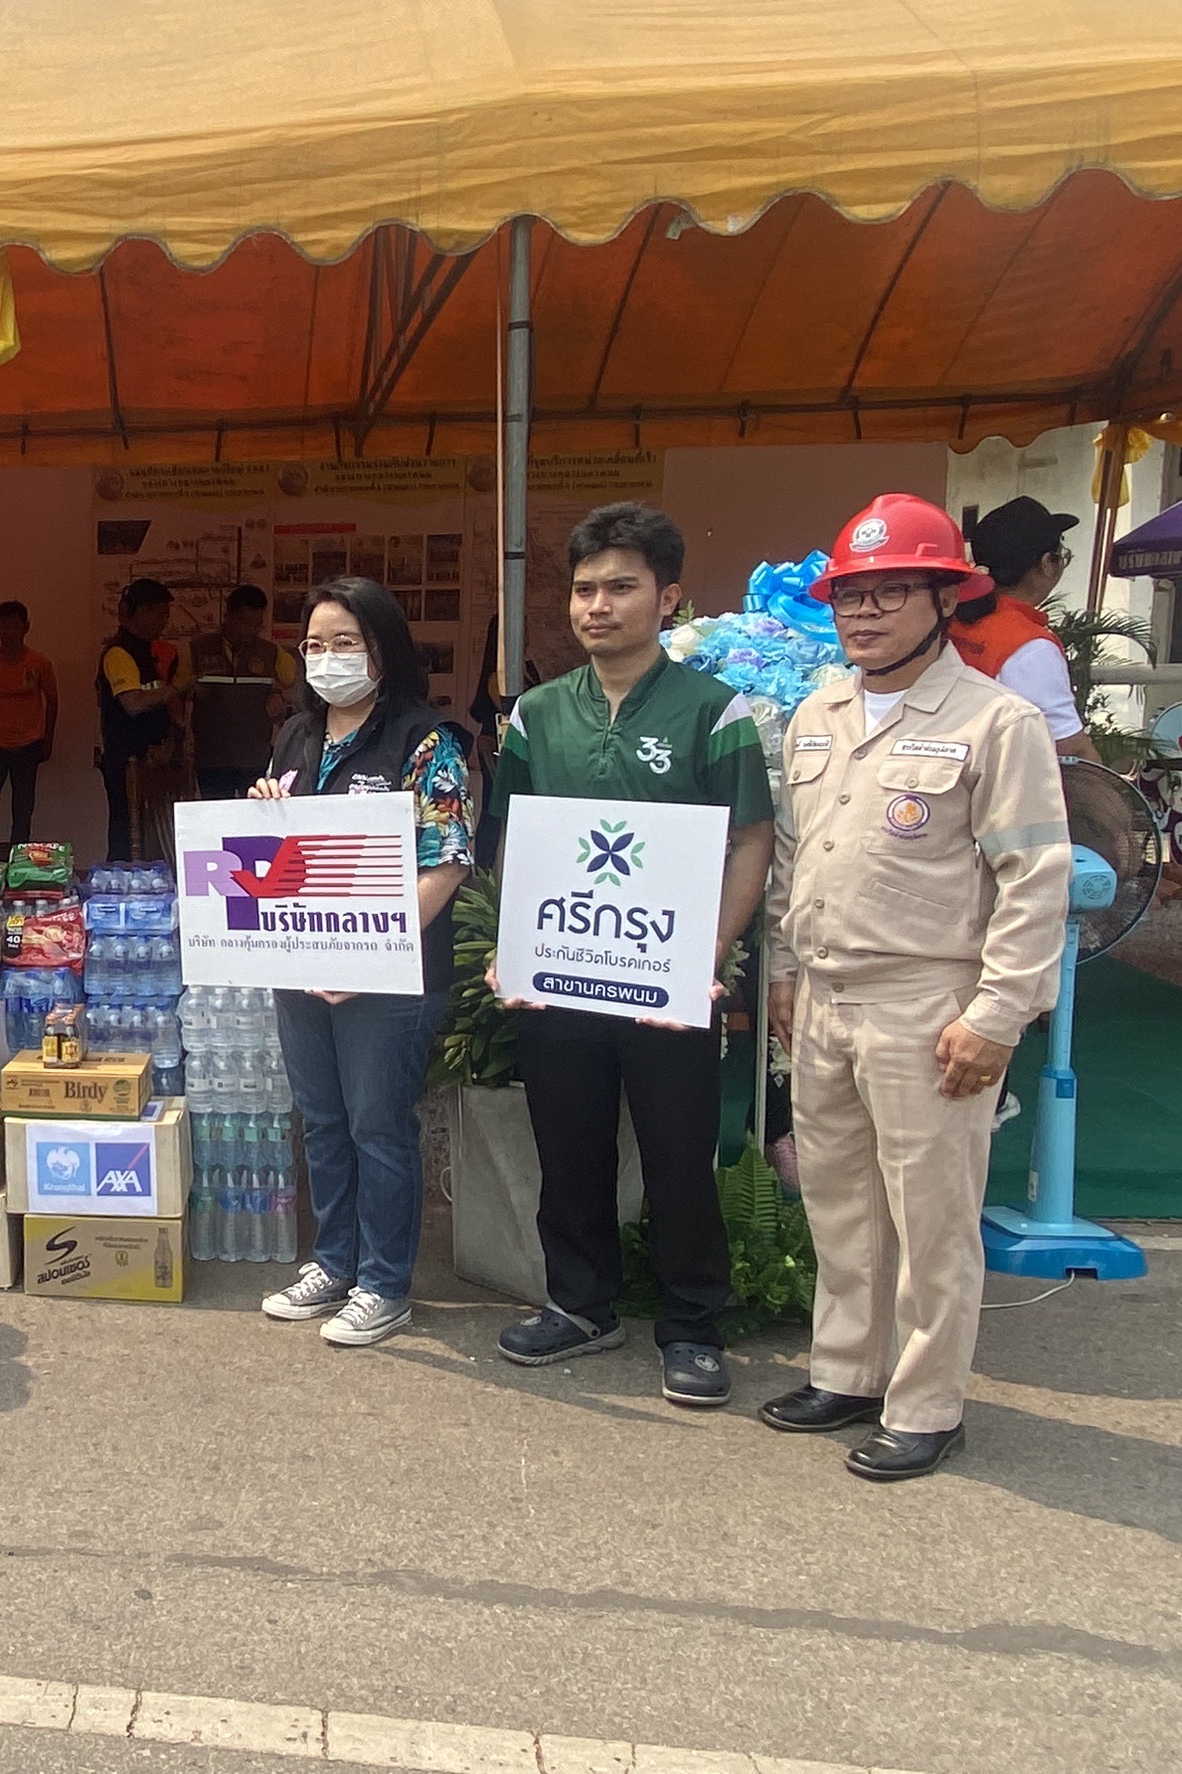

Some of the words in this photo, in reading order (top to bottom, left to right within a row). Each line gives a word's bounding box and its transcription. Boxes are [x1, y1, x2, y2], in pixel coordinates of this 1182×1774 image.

[260, 902, 408, 934] บริษัทกลางฯ
[536, 889, 676, 954] ศรีกรุง
[5, 935, 21, 944] 40
[188, 934, 216, 949] บริษัท
[220, 936, 378, 953] กลางคุ้มครองผู้ประสบภัยจากรถ
[384, 937, 415, 952] จำกัด
[534, 942, 672, 974] ประกันชีวิตโบรคเกอร์
[542, 976, 658, 1004] สาขานครพนม
[63, 1080, 109, 1104] Birdy
[97, 1170, 143, 1192] AXA
